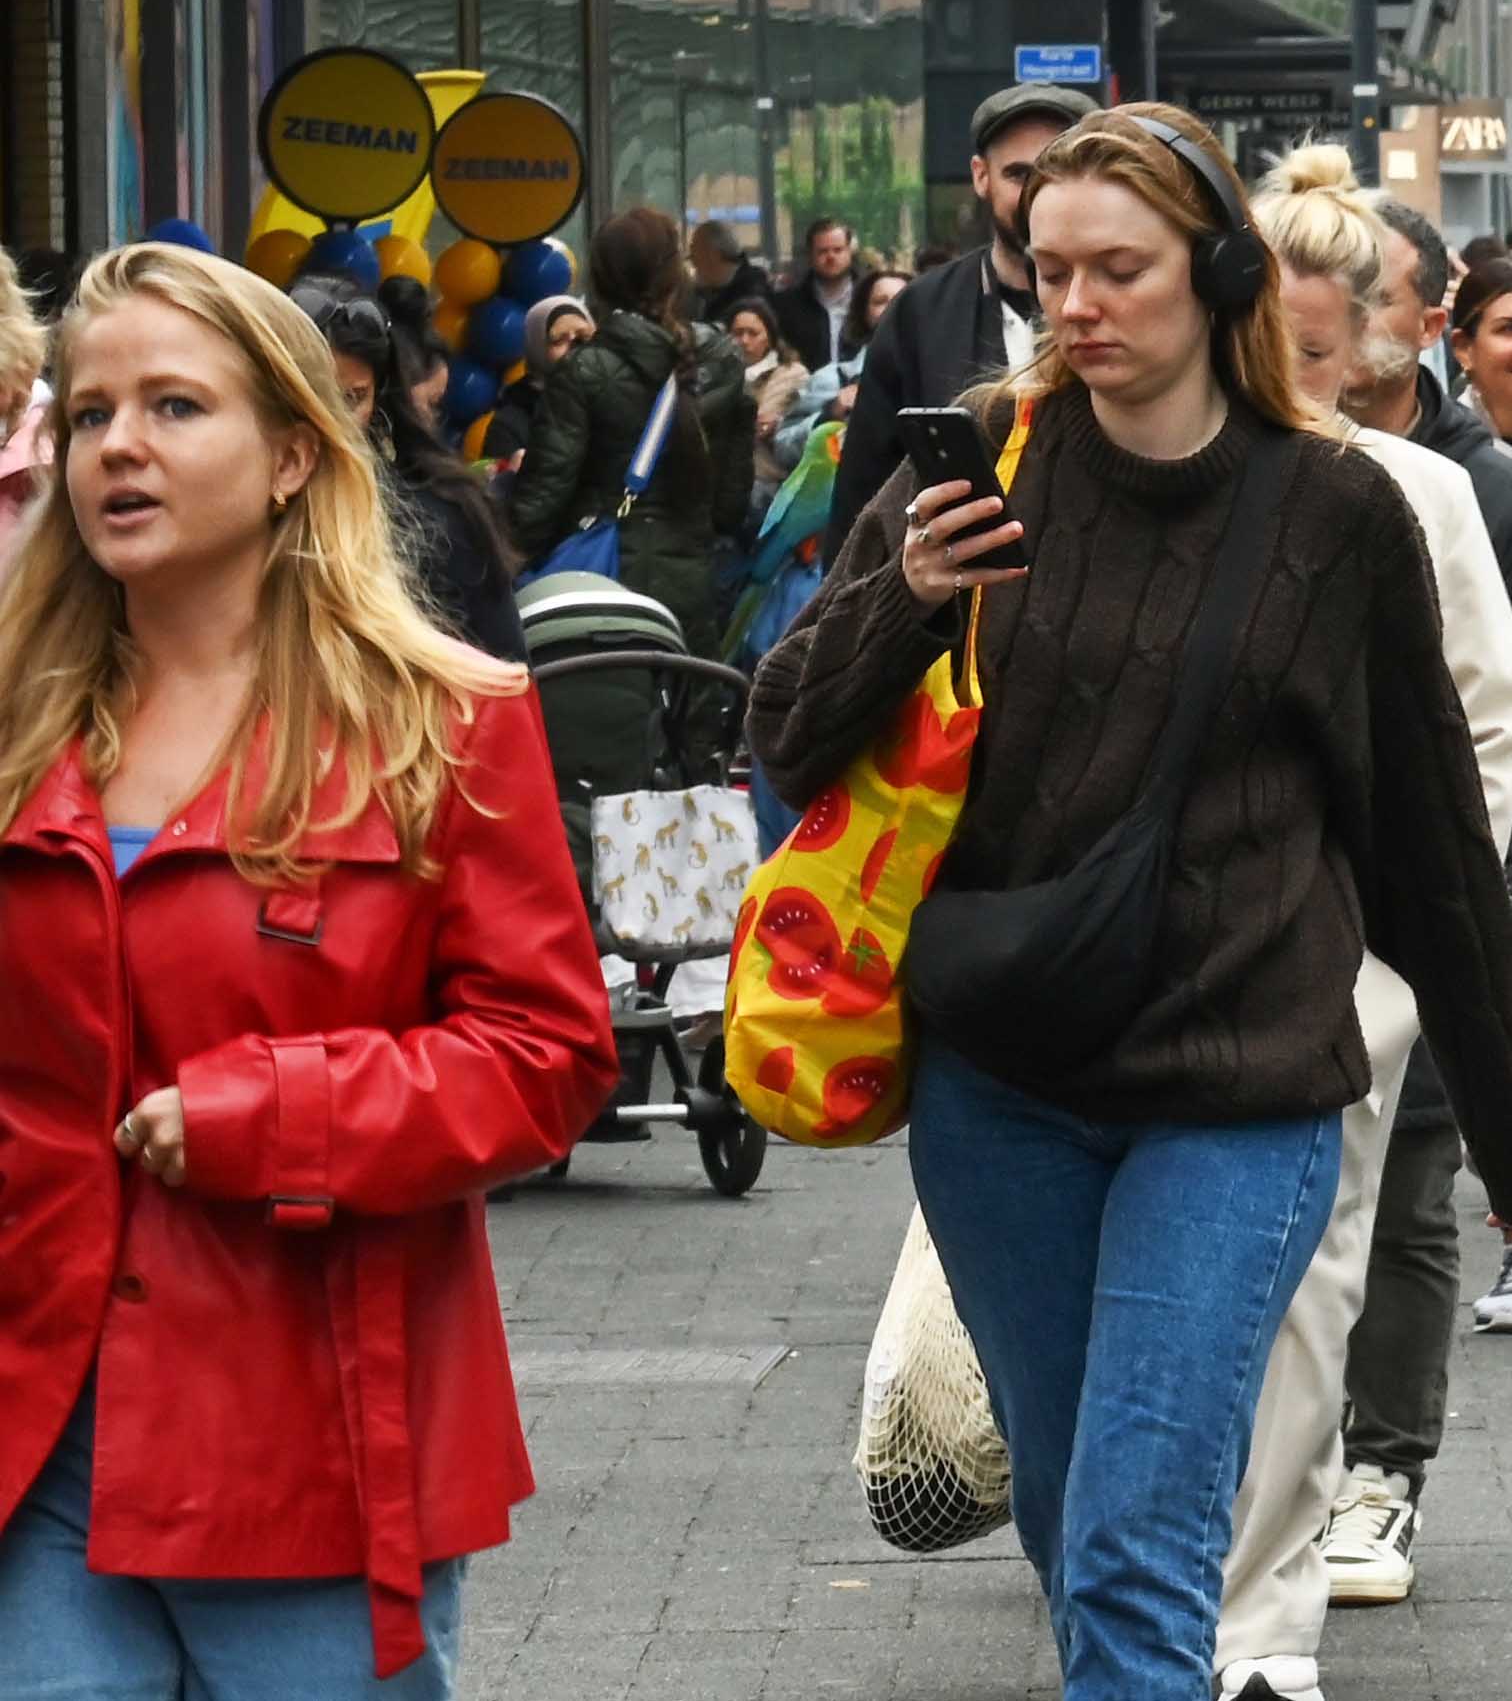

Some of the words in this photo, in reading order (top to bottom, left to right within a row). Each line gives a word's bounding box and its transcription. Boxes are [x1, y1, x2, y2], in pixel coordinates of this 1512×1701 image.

[282, 116, 418, 155] ZEEMAN
[1440, 115, 1507, 151] ZARA
[443, 156, 569, 181] ZEEMAN
